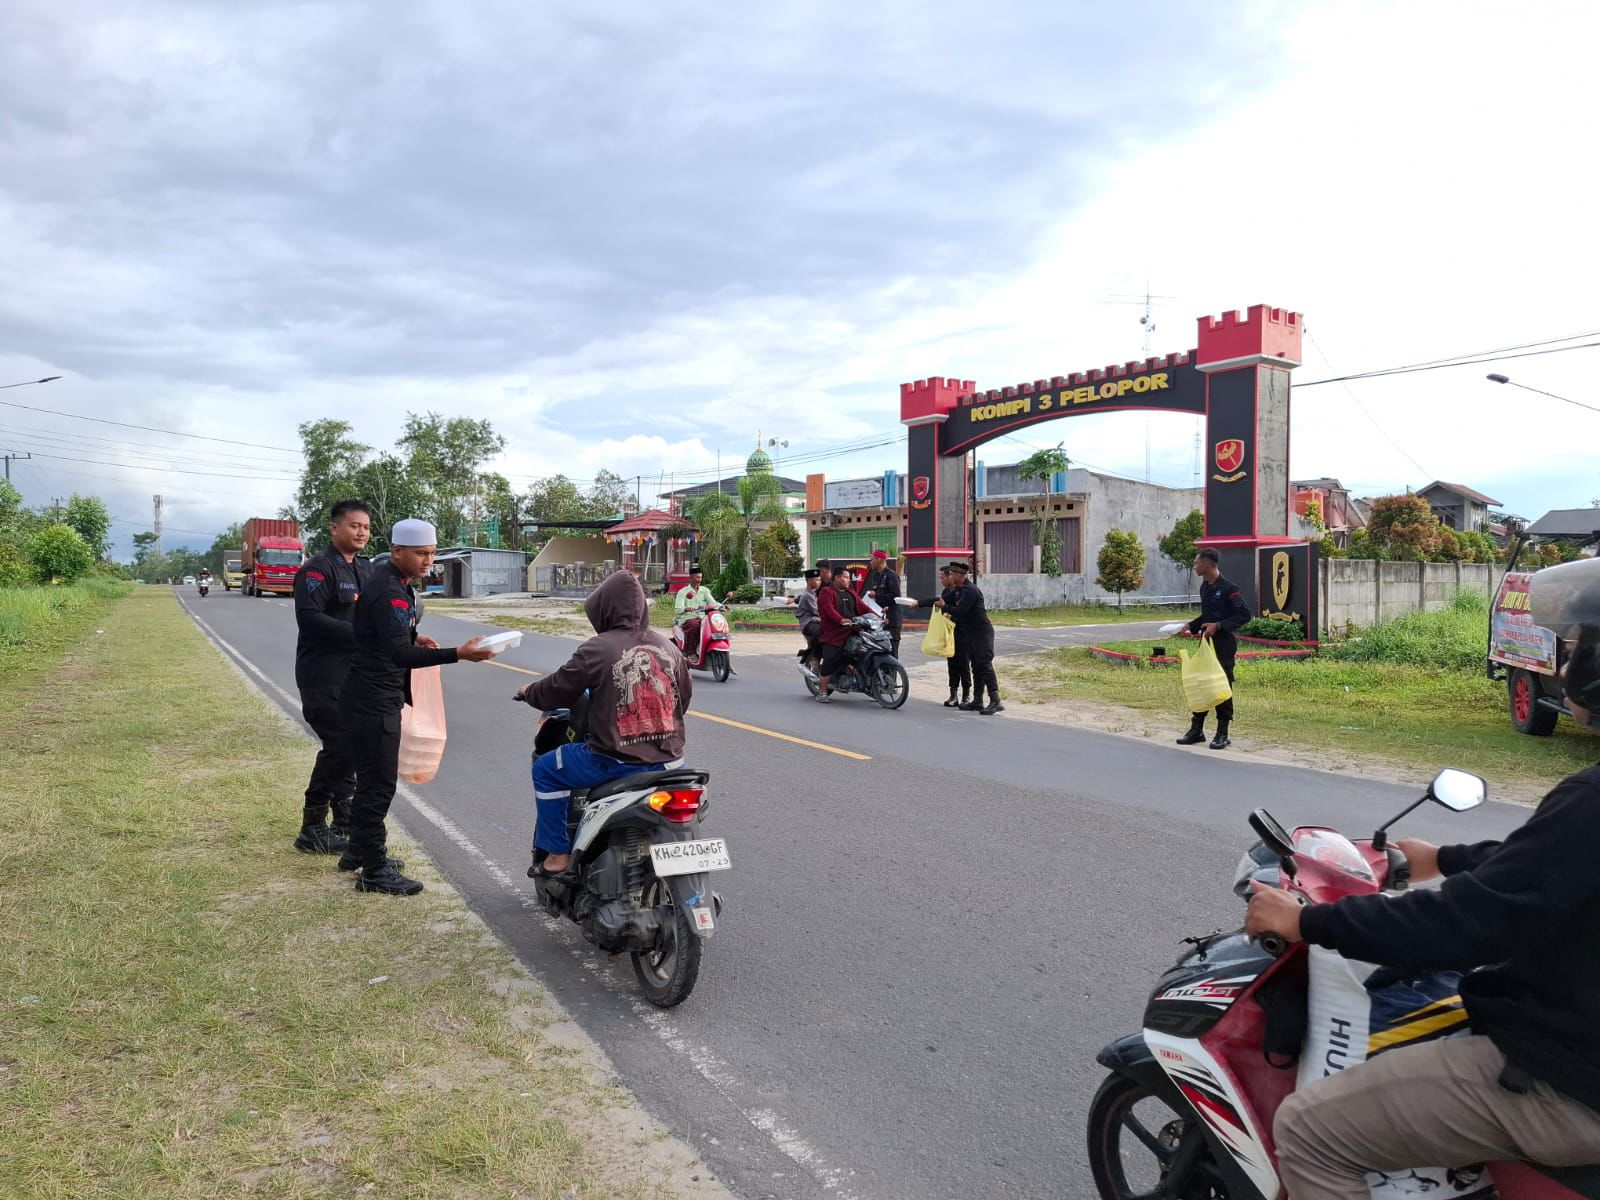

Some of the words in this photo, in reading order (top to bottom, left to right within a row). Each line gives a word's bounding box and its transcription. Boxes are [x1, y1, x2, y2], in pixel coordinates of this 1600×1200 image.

[970, 397, 1031, 422] KOMPI
[1038, 394, 1052, 410] 3
[1059, 372, 1169, 407] PELOPOR
[654, 847, 670, 861] KH
[1159, 1048, 1184, 1063] YAMAHA
